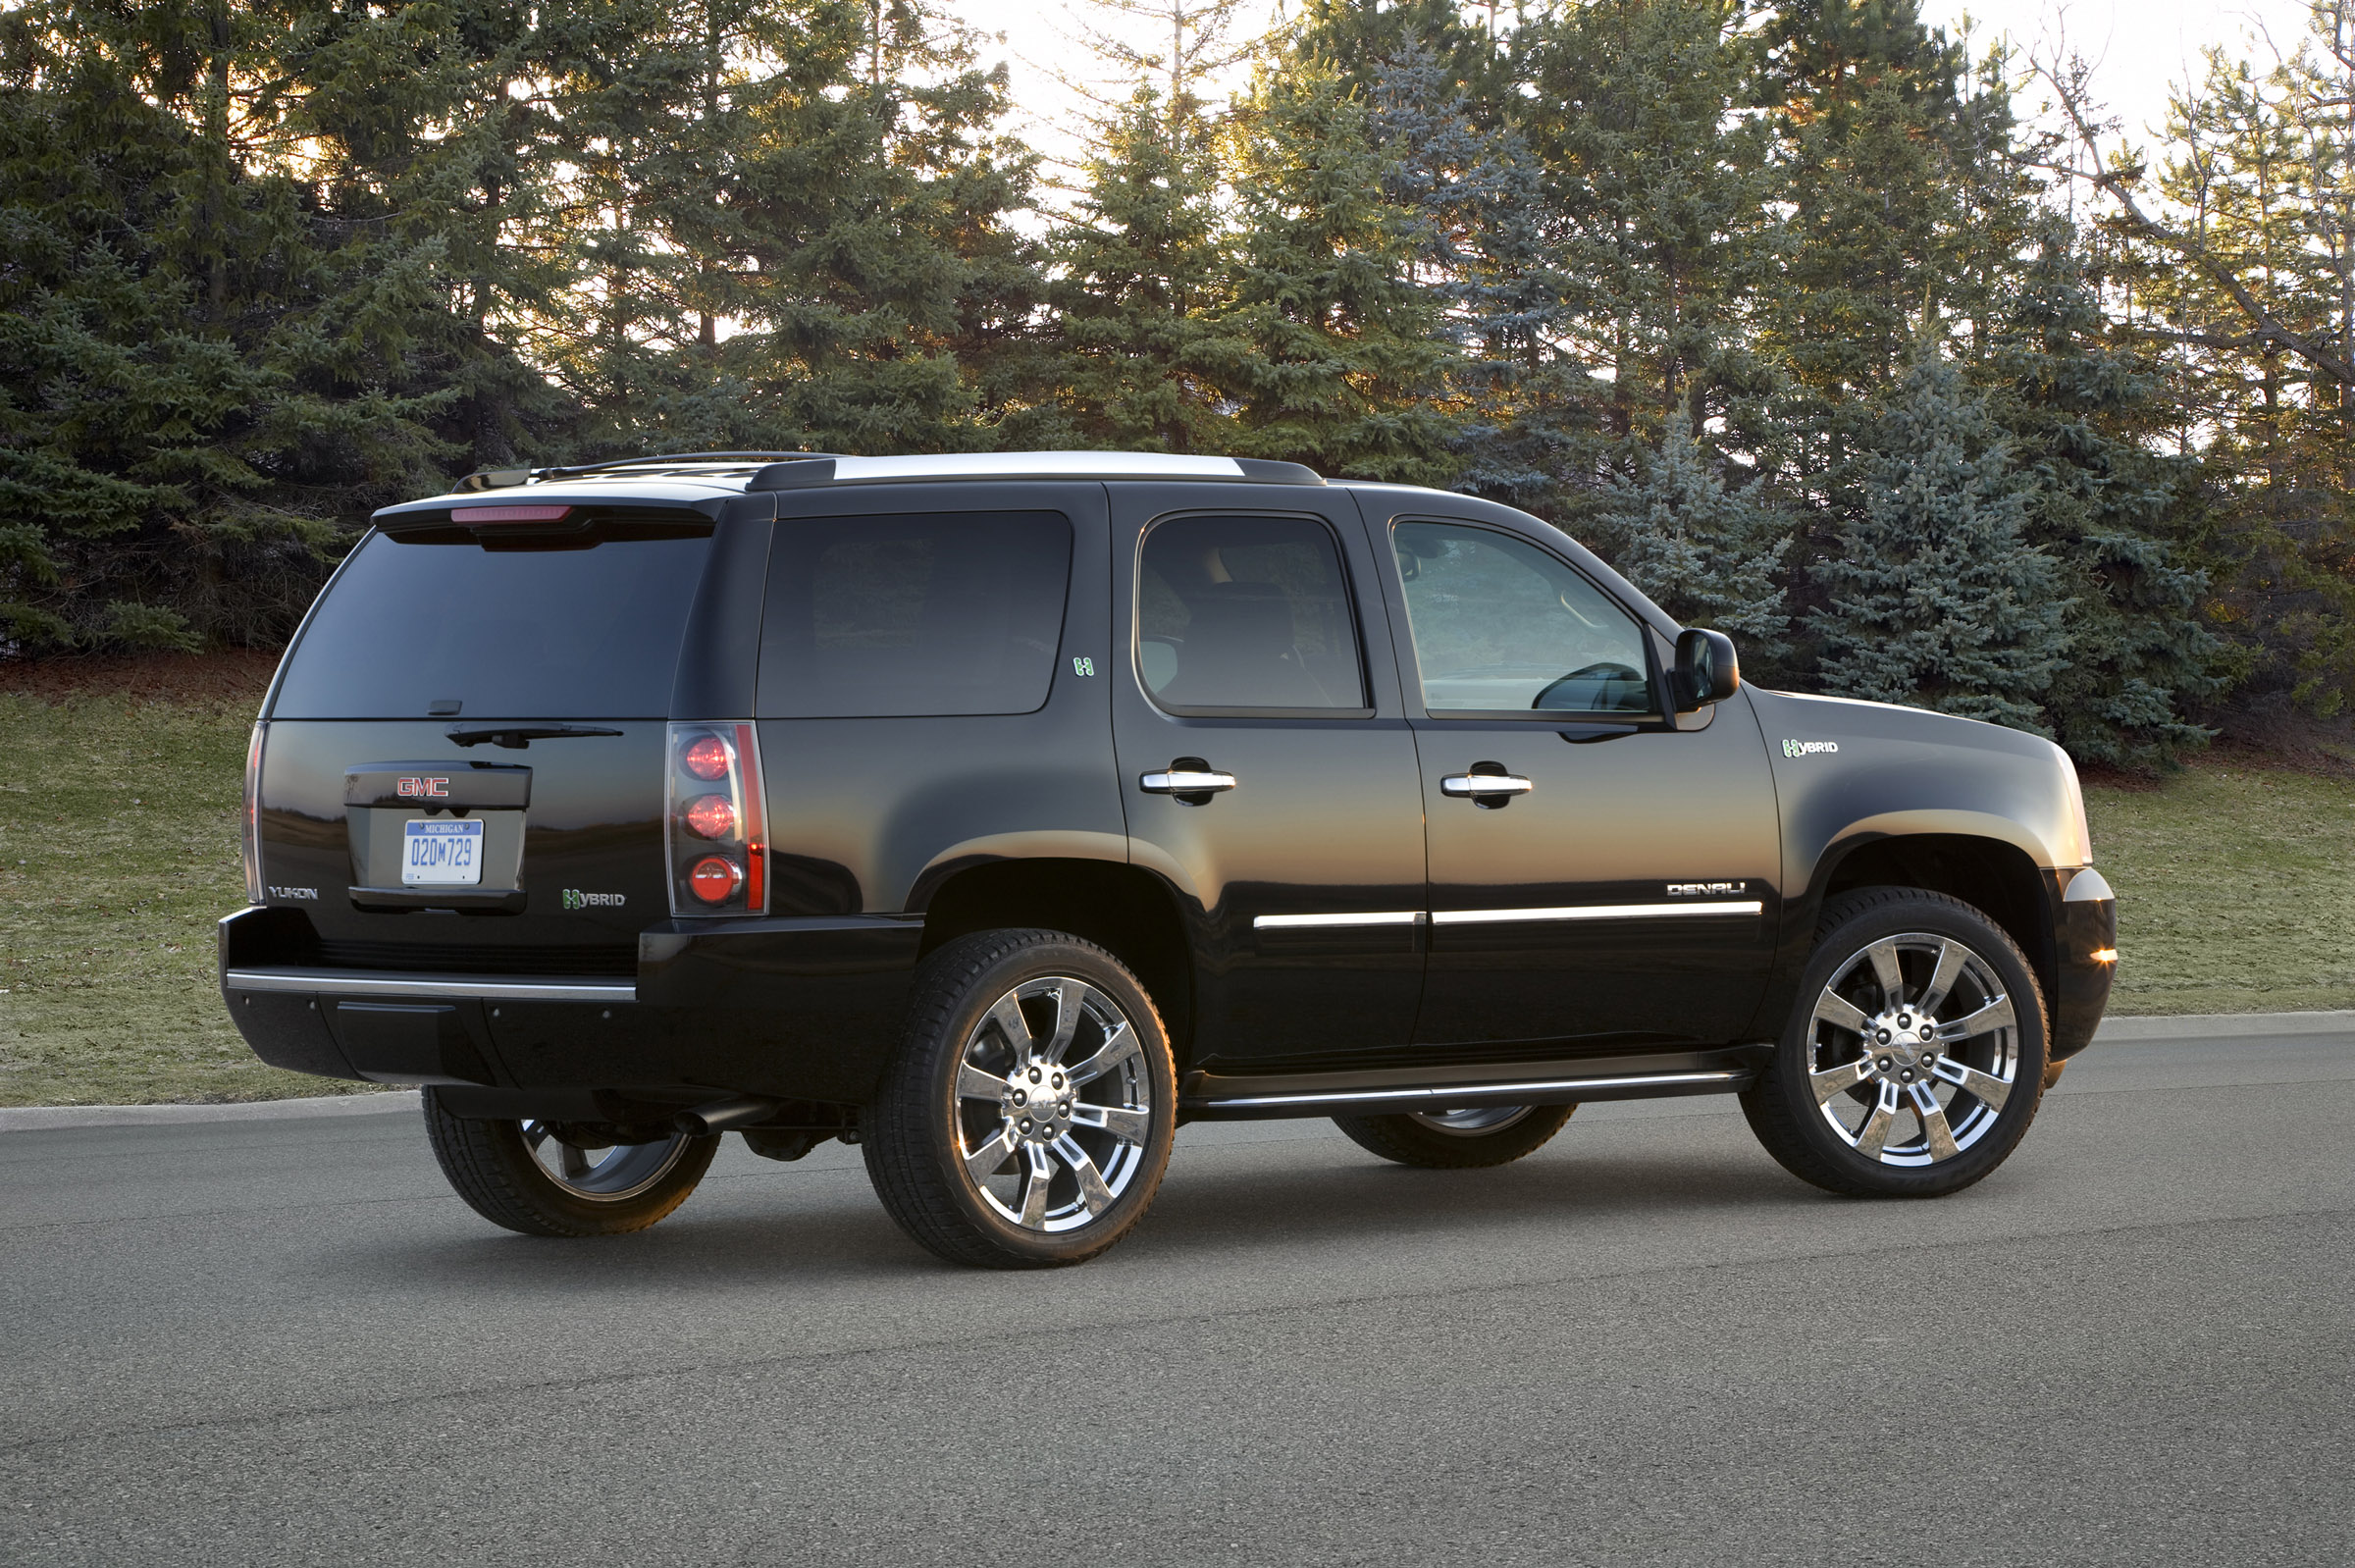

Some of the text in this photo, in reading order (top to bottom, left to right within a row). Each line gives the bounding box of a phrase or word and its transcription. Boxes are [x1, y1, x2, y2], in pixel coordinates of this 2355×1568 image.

[397, 777, 449, 796] GMC
[425, 824, 464, 834] MICHIGAN
[411, 838, 472, 865] 020M729
[268, 886, 319, 900] YUKON
[1667, 882, 1746, 896] DENALI
